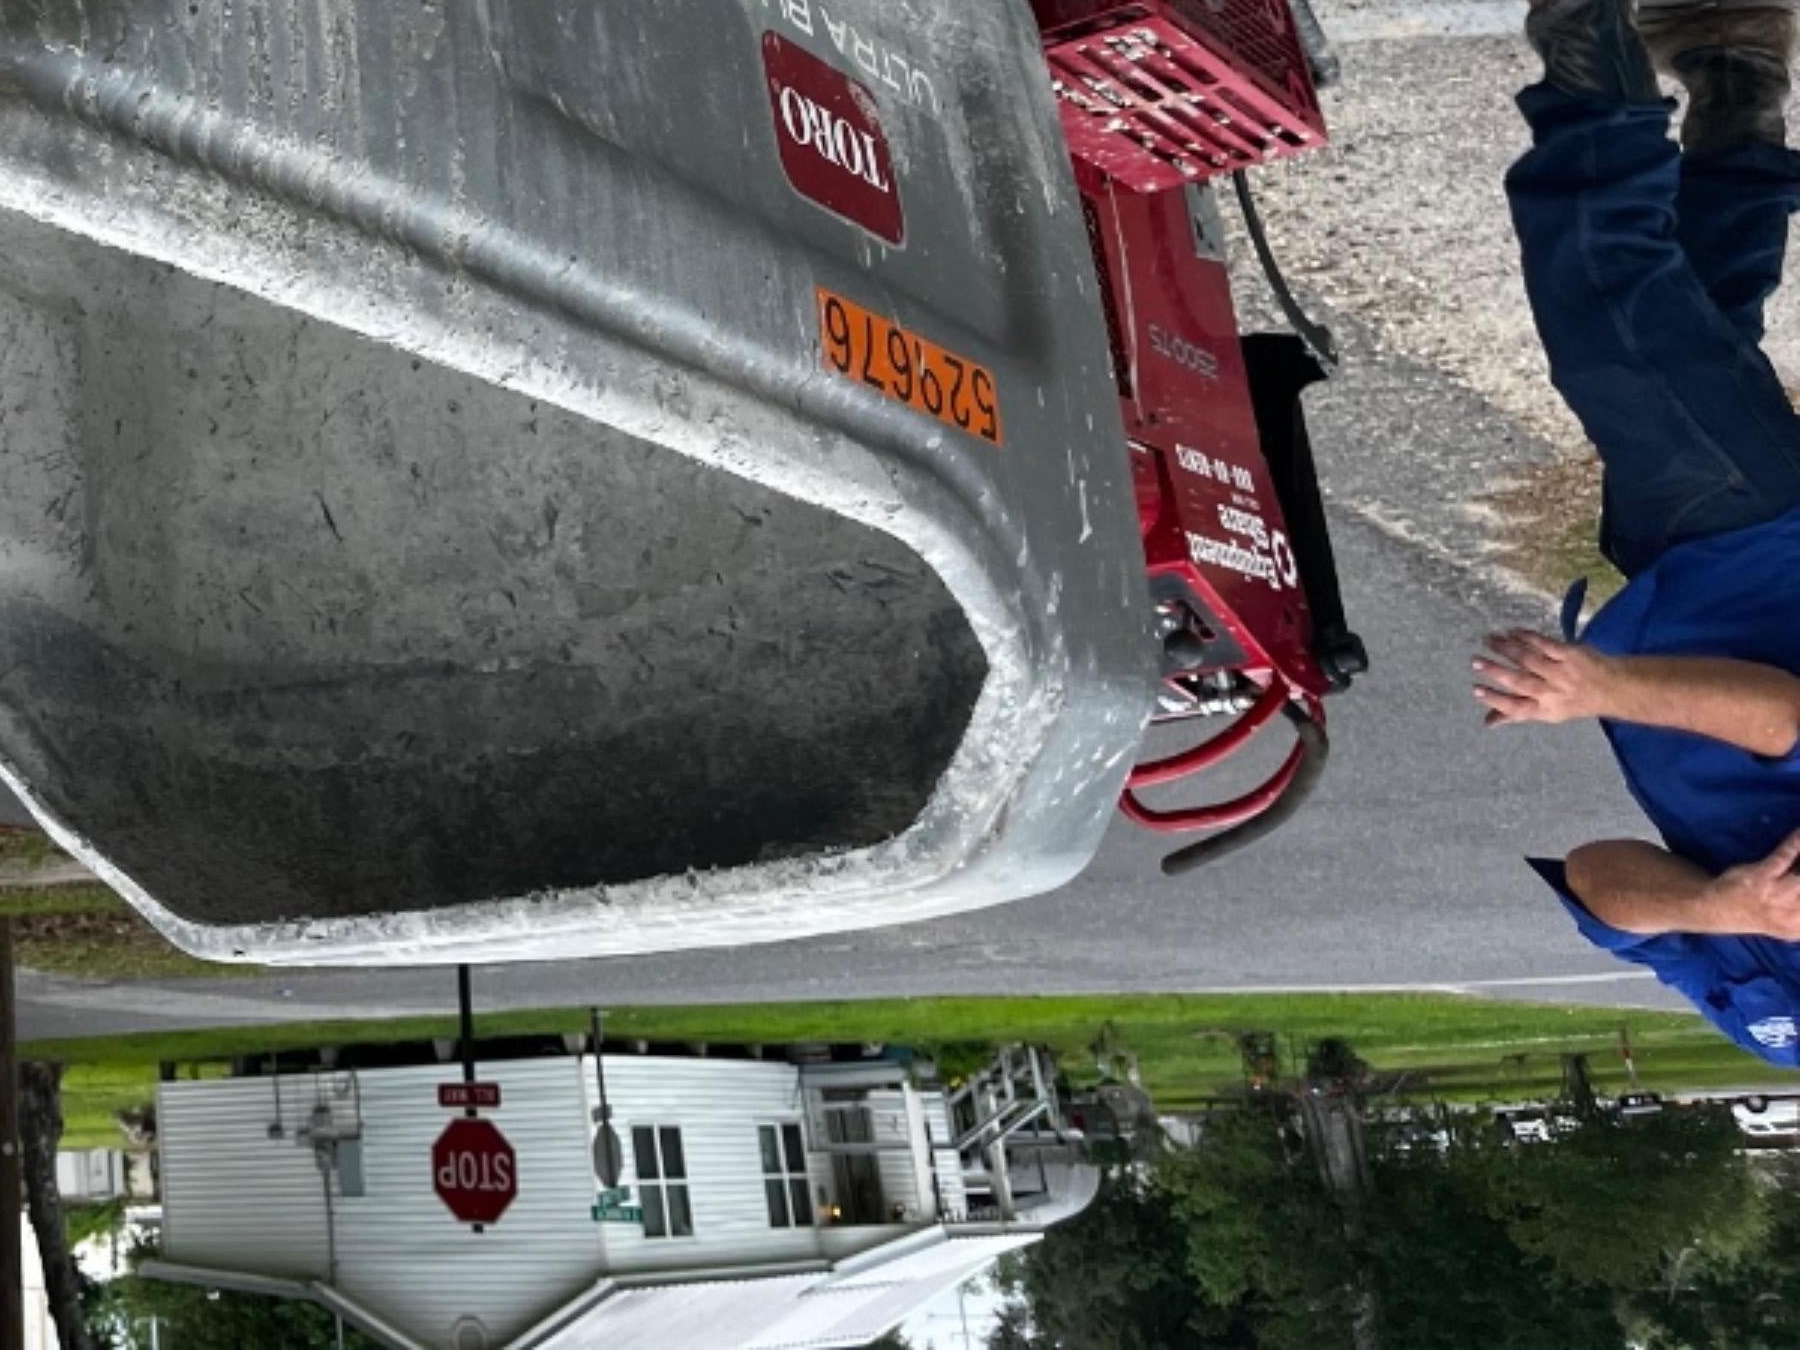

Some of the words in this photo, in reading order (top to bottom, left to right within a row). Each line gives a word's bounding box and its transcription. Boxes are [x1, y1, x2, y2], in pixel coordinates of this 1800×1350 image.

[819, 5, 941, 117] ULTRA
[778, 84, 889, 194] TORO
[824, 297, 997, 441] 529676
[1185, 530, 1281, 591] Equipment
[1217, 504, 1269, 550] Share
[438, 1151, 511, 1191] STOP
